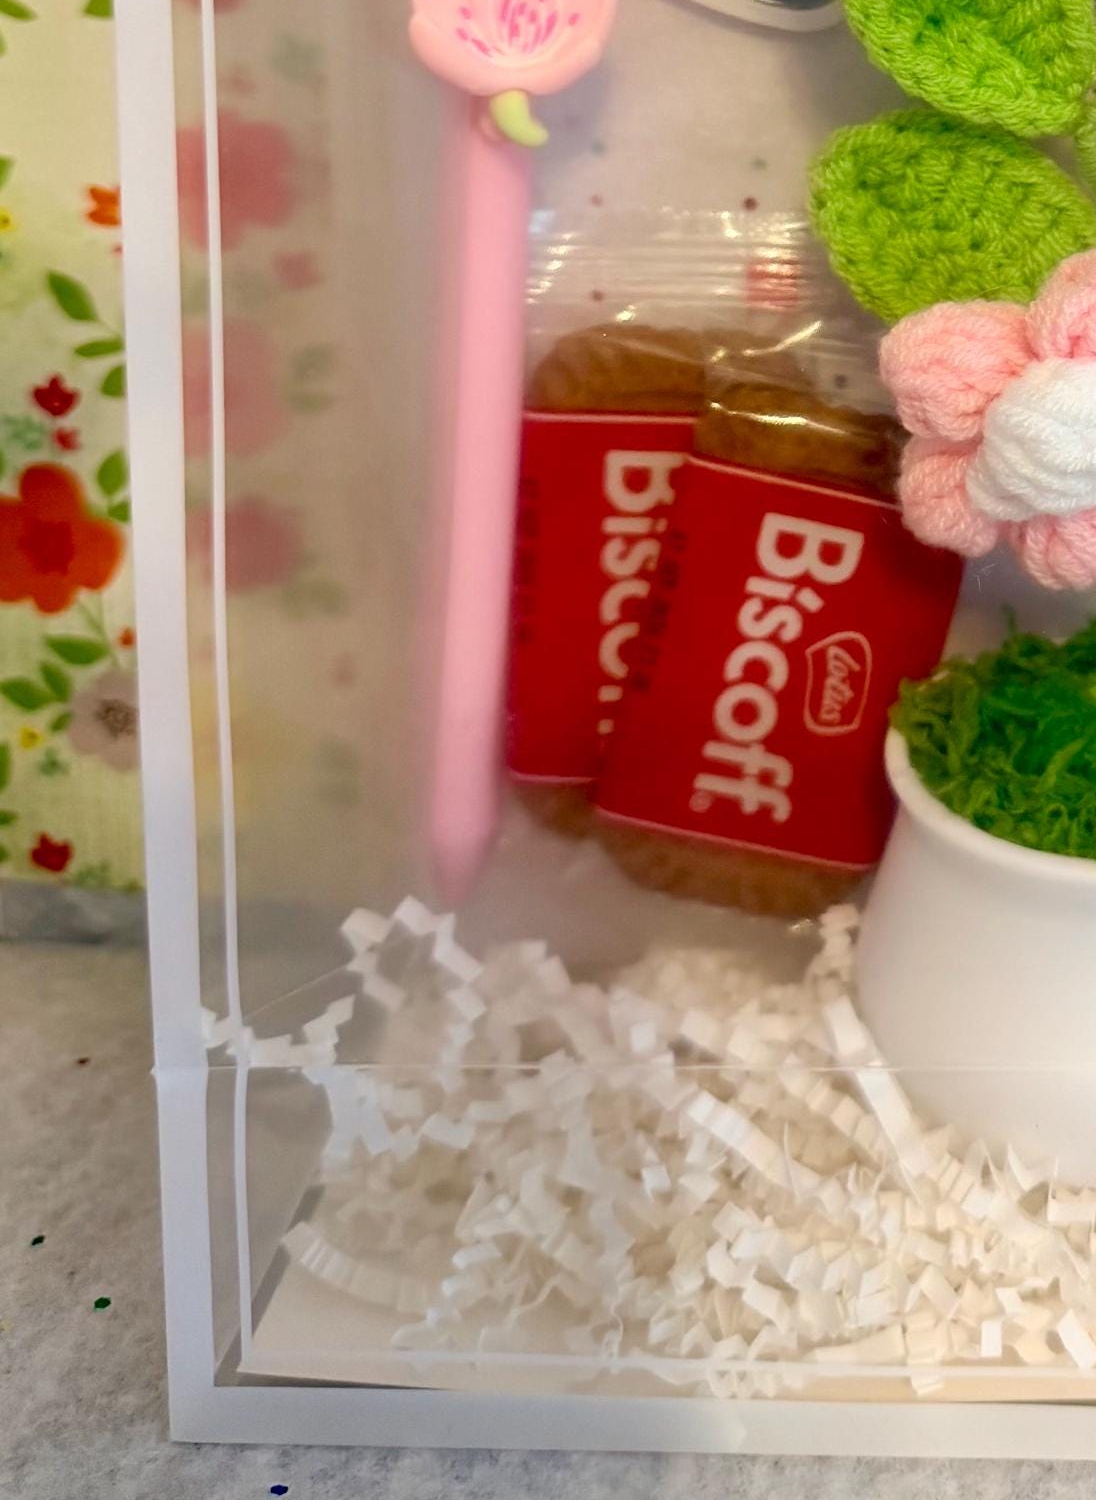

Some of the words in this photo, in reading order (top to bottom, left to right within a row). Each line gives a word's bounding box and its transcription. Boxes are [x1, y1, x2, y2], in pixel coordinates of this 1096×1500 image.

[597, 450, 690, 734] Bisco
[693, 511, 864, 823] Biscoff
[819, 643, 861, 725] Lotus
